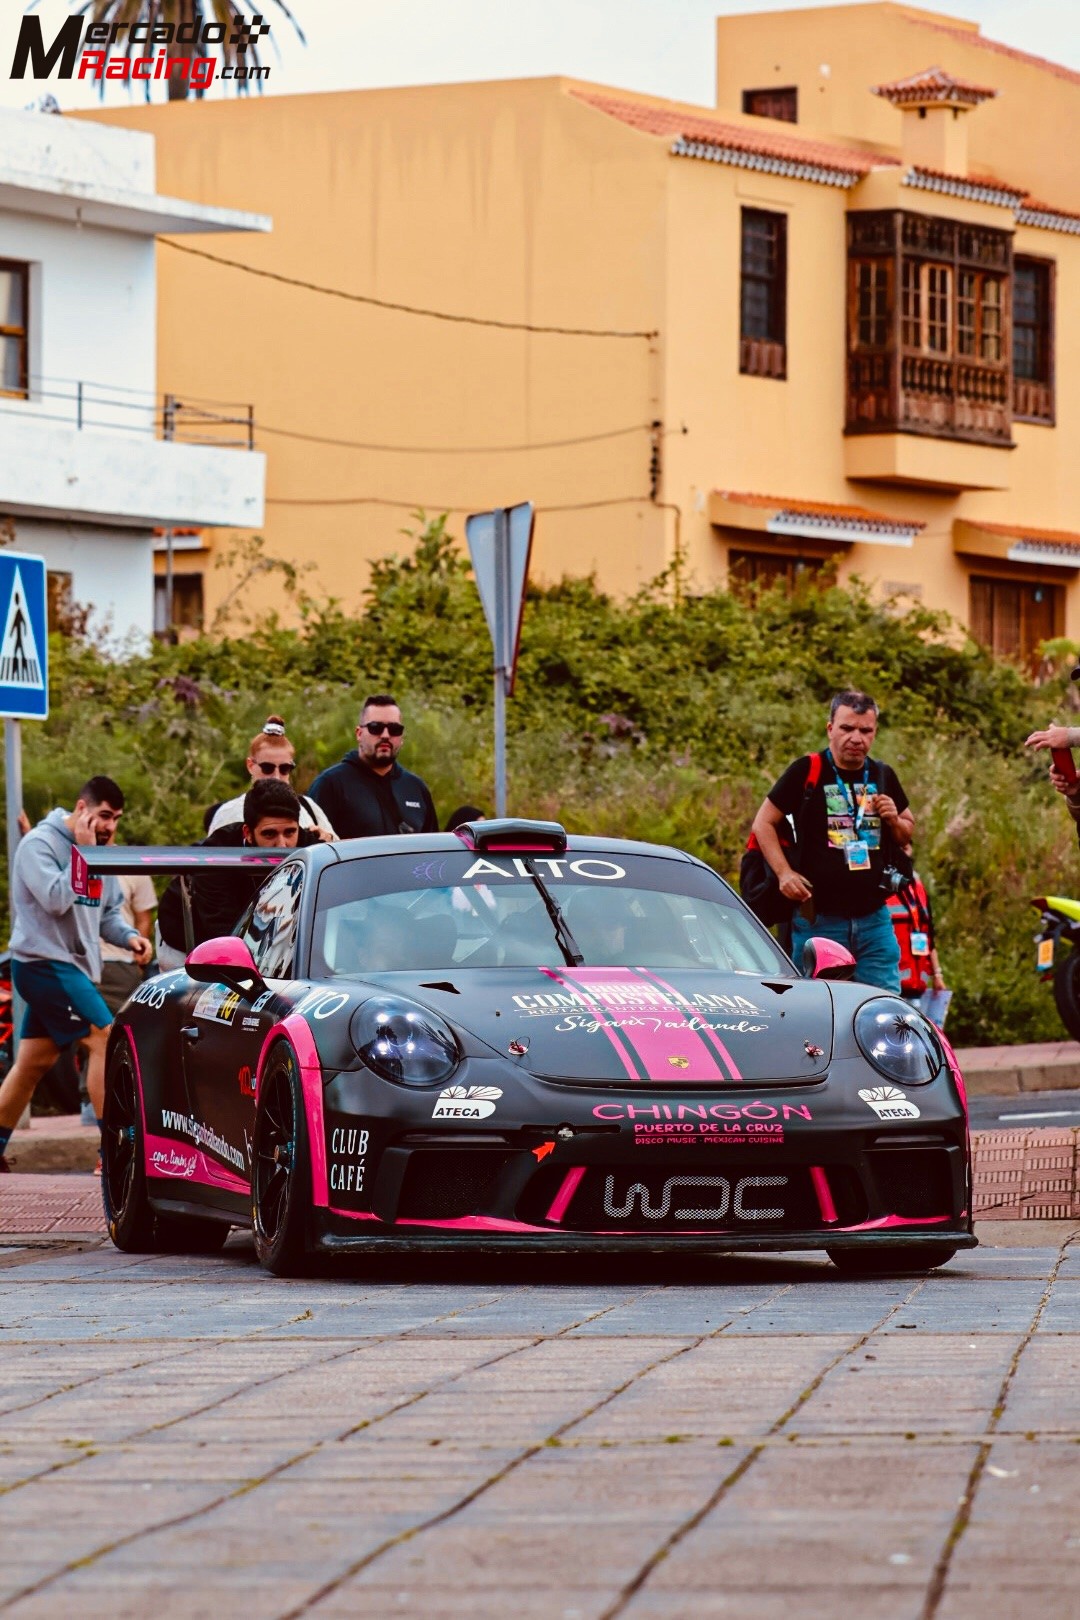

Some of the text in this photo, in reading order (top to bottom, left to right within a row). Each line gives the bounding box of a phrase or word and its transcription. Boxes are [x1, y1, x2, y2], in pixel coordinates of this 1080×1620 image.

[462, 858, 627, 880] ALTO
[585, 985, 663, 994] GRUPO
[511, 992, 759, 1009] COMPOSTELANA
[435, 1107, 480, 1117] ATECA
[592, 1101, 813, 1121] CHINGÓN
[878, 1108, 915, 1118] ATECA
[634, 1123, 784, 1133] PUERTO DE LA CRUZ
[331, 1127, 370, 1156] CLUB
[634, 1137, 664, 1145] DISCO
[748, 1136, 785, 1144] CUISINE
[330, 1159, 366, 1192] CAFÉ
